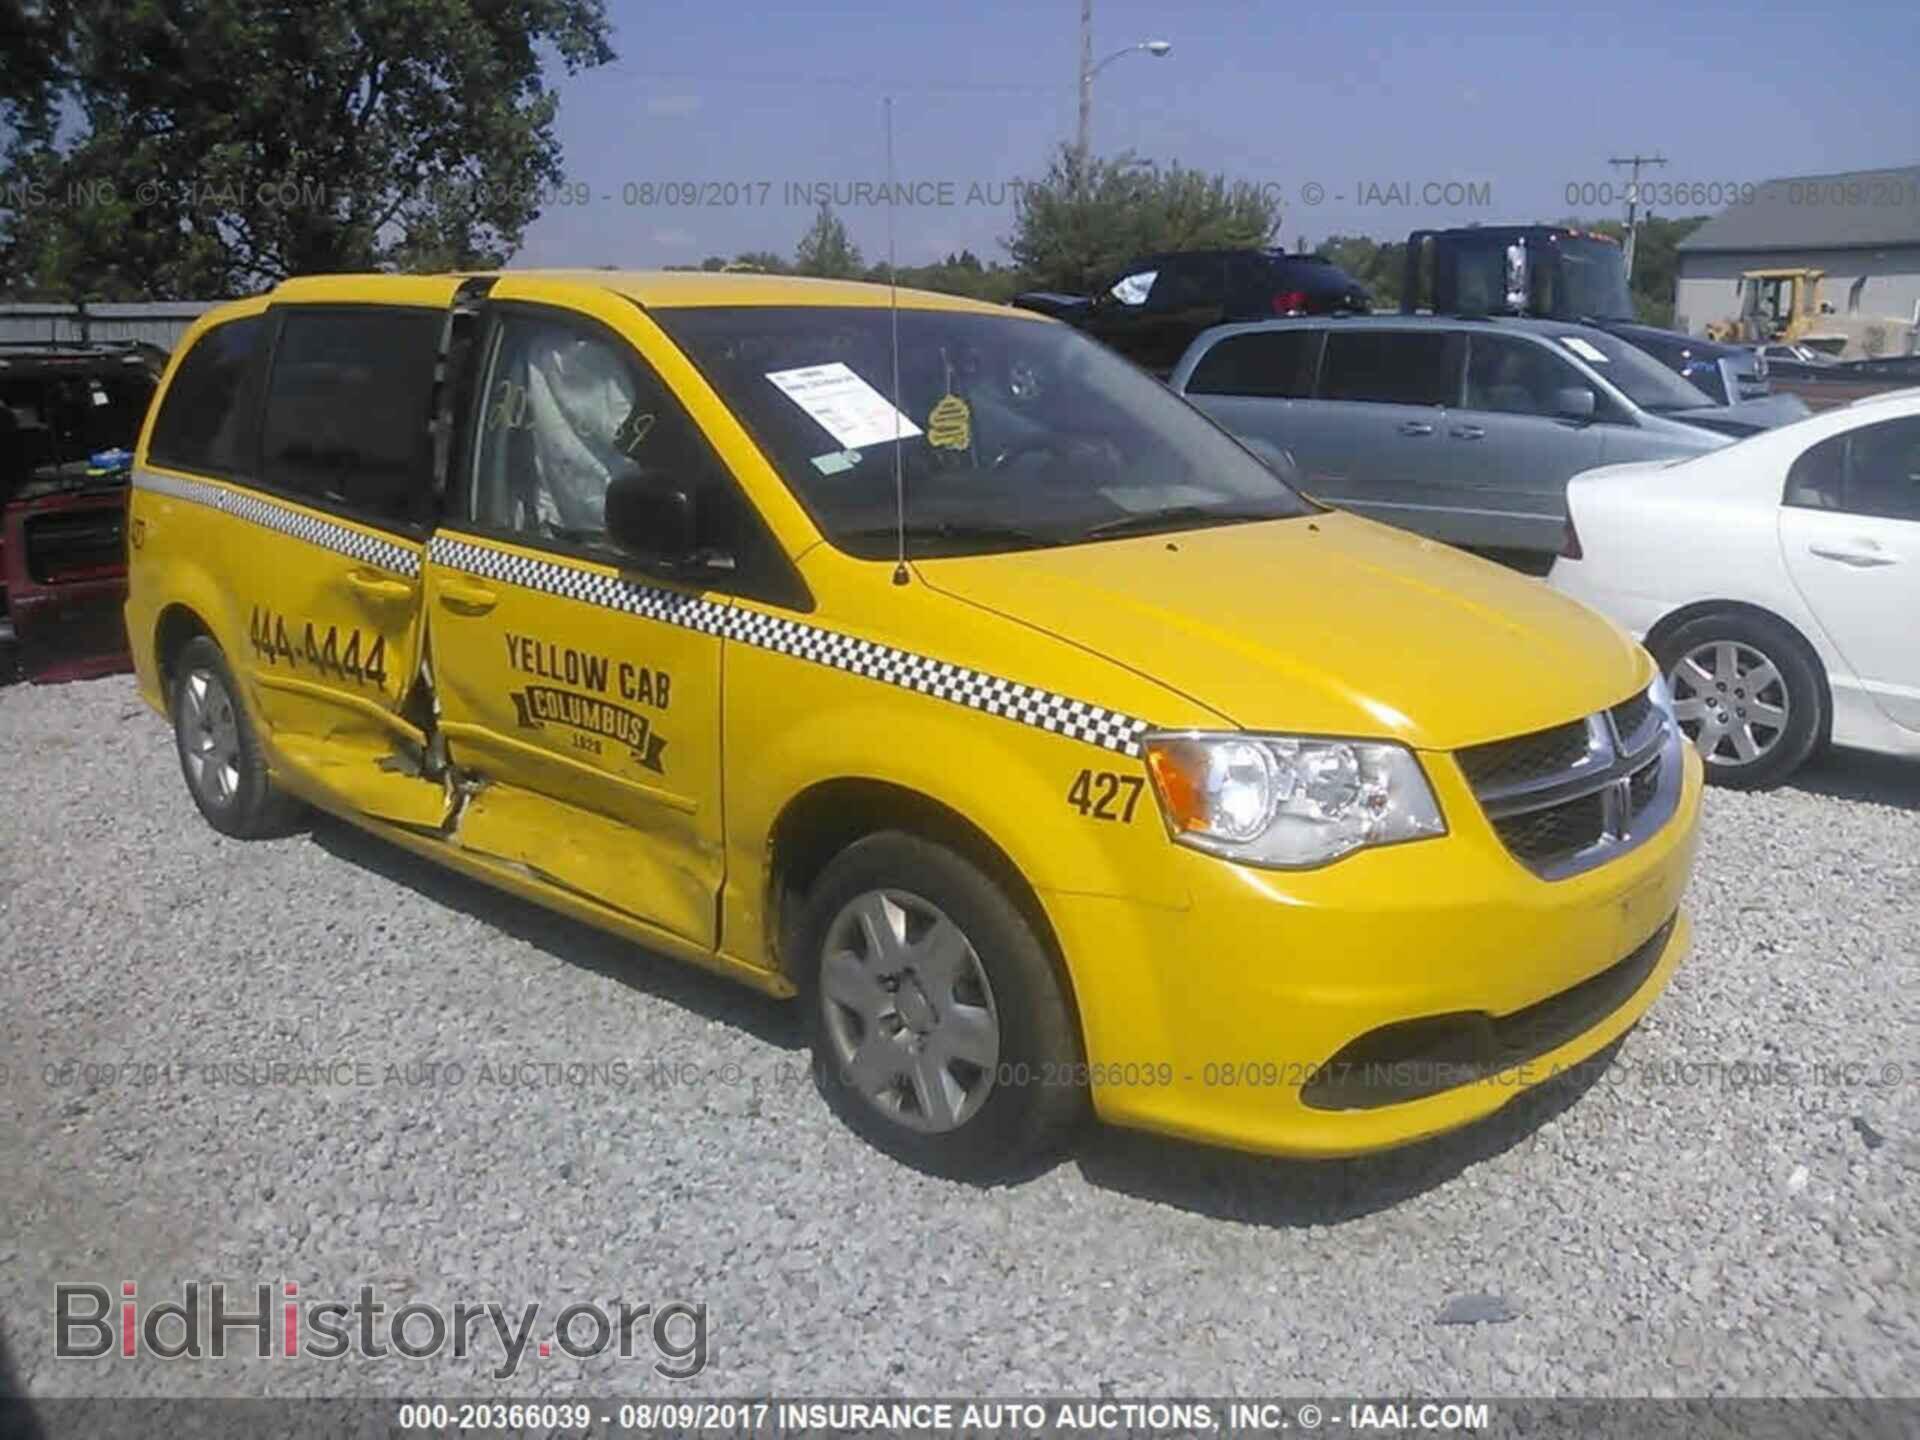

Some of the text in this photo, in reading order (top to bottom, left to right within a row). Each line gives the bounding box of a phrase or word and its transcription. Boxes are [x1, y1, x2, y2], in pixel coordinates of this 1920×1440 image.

[251, 605, 388, 692] 444-4444
[505, 632, 671, 710] YELLOW CAB
[533, 688, 642, 746] COLUMBUS
[1067, 769, 1145, 824] 427
